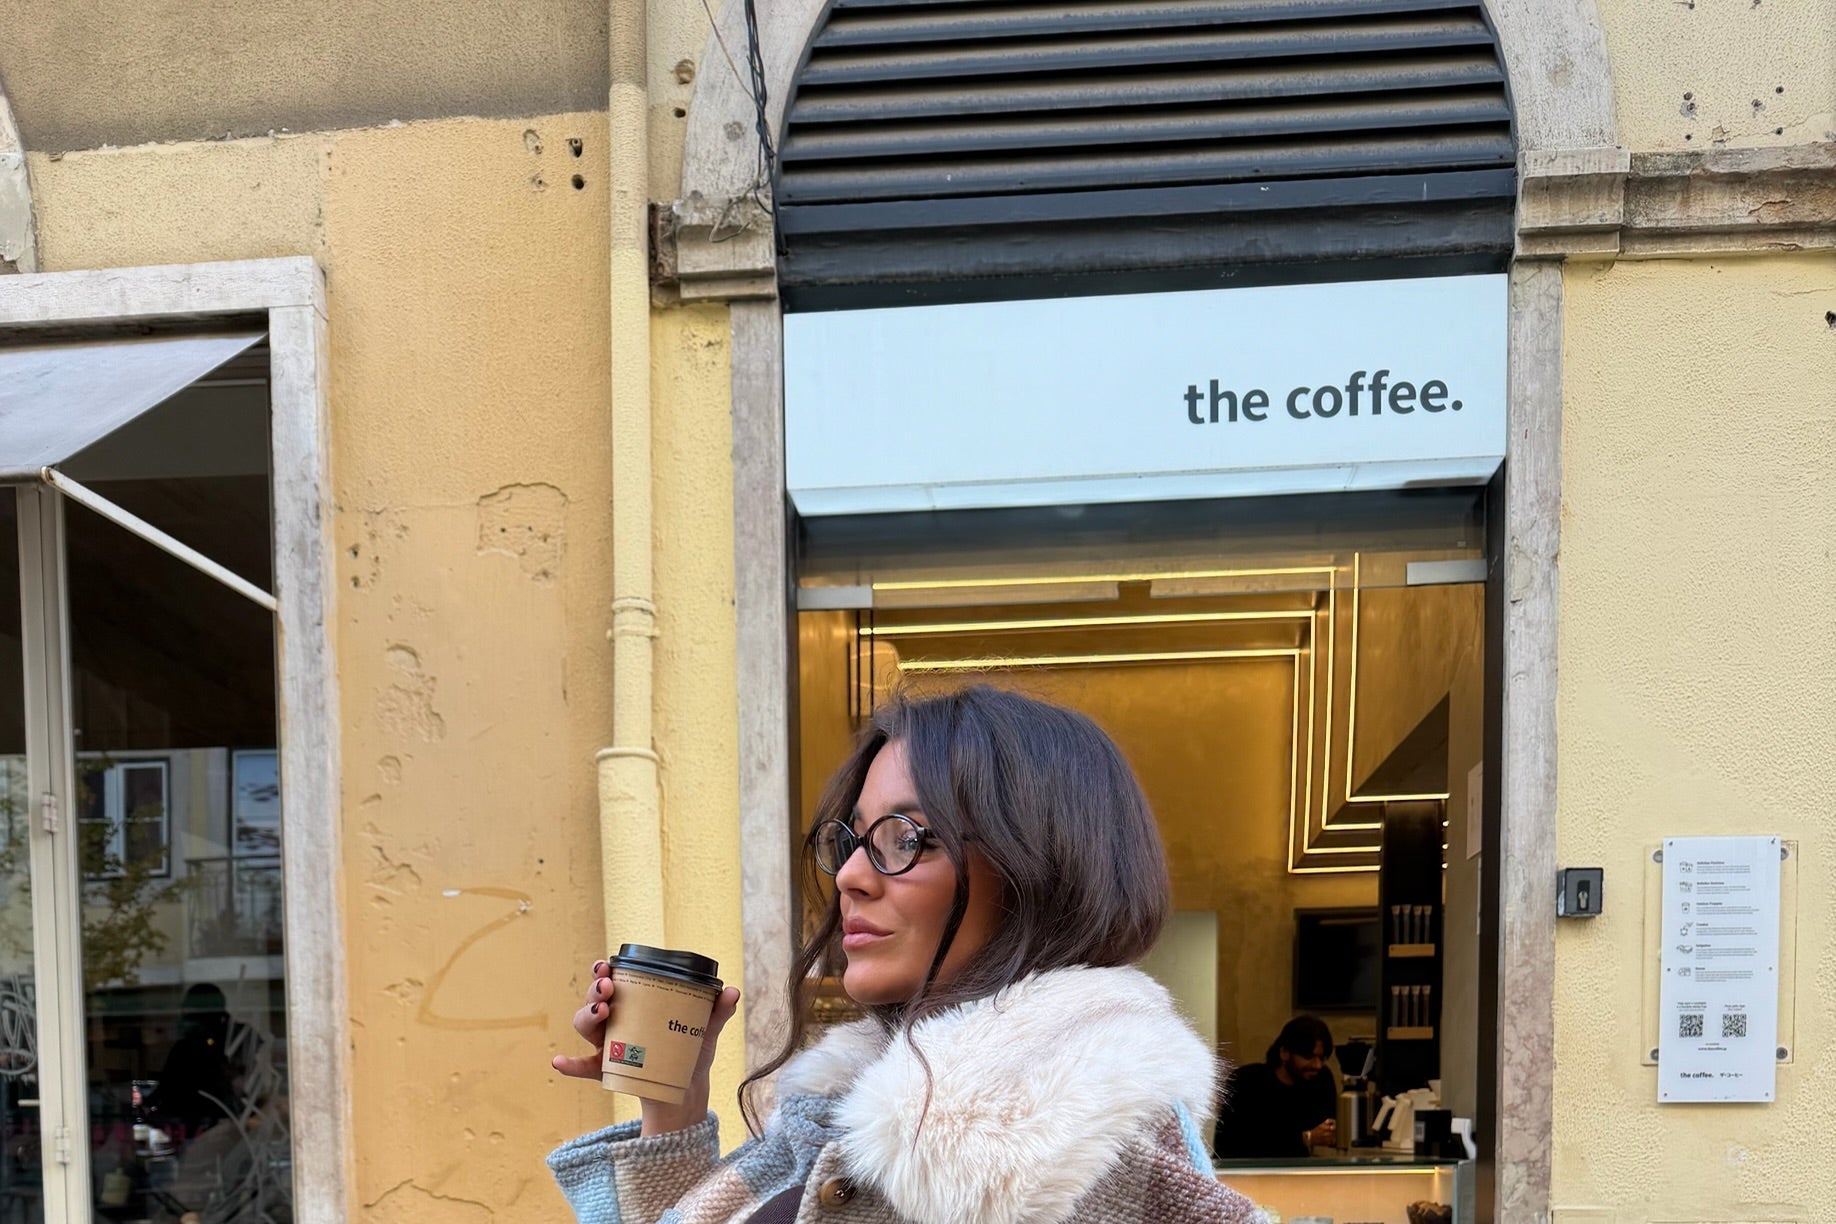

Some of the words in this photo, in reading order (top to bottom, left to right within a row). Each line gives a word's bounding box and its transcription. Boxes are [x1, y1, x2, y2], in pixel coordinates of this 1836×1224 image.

[1183, 379, 1270, 424] the
[1286, 369, 1463, 419] coffee.
[668, 1019, 688, 1034] the
